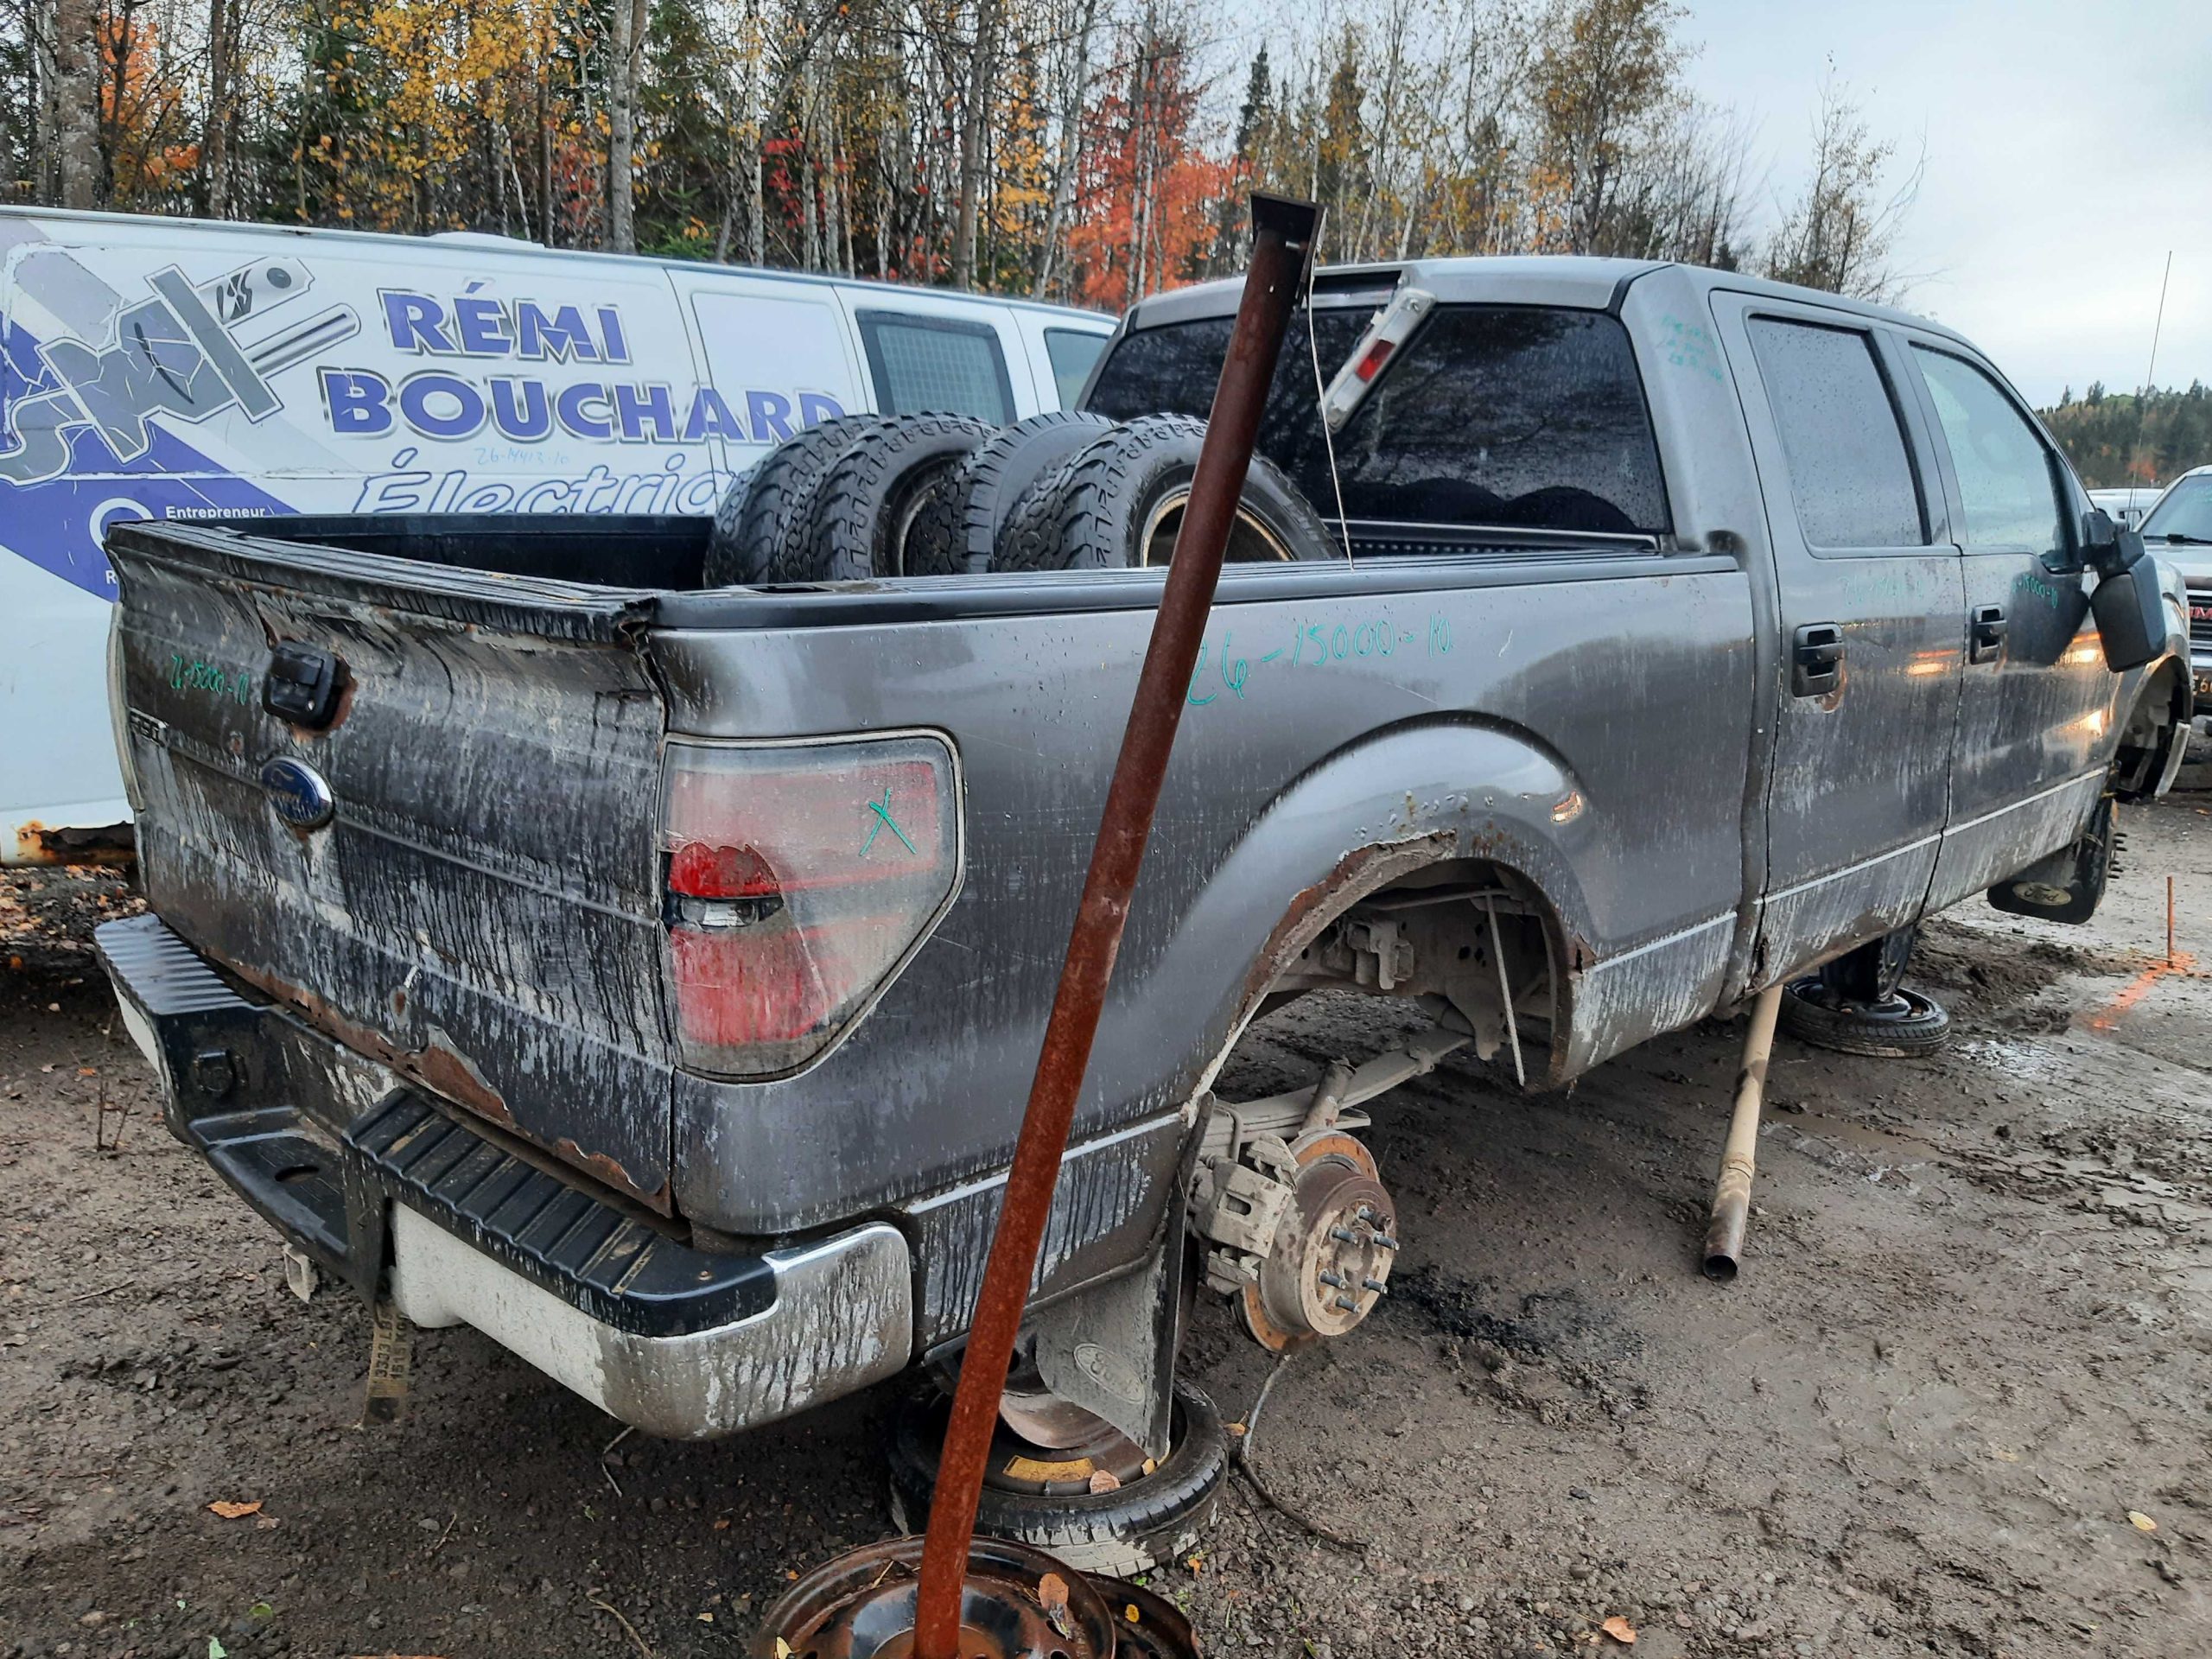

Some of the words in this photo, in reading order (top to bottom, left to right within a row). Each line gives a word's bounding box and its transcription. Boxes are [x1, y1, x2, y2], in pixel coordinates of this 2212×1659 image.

[378, 279, 632, 365] RÉMI
[317, 366, 850, 444] BOUCHARD
[165, 505, 266, 518] Entrepreneur
